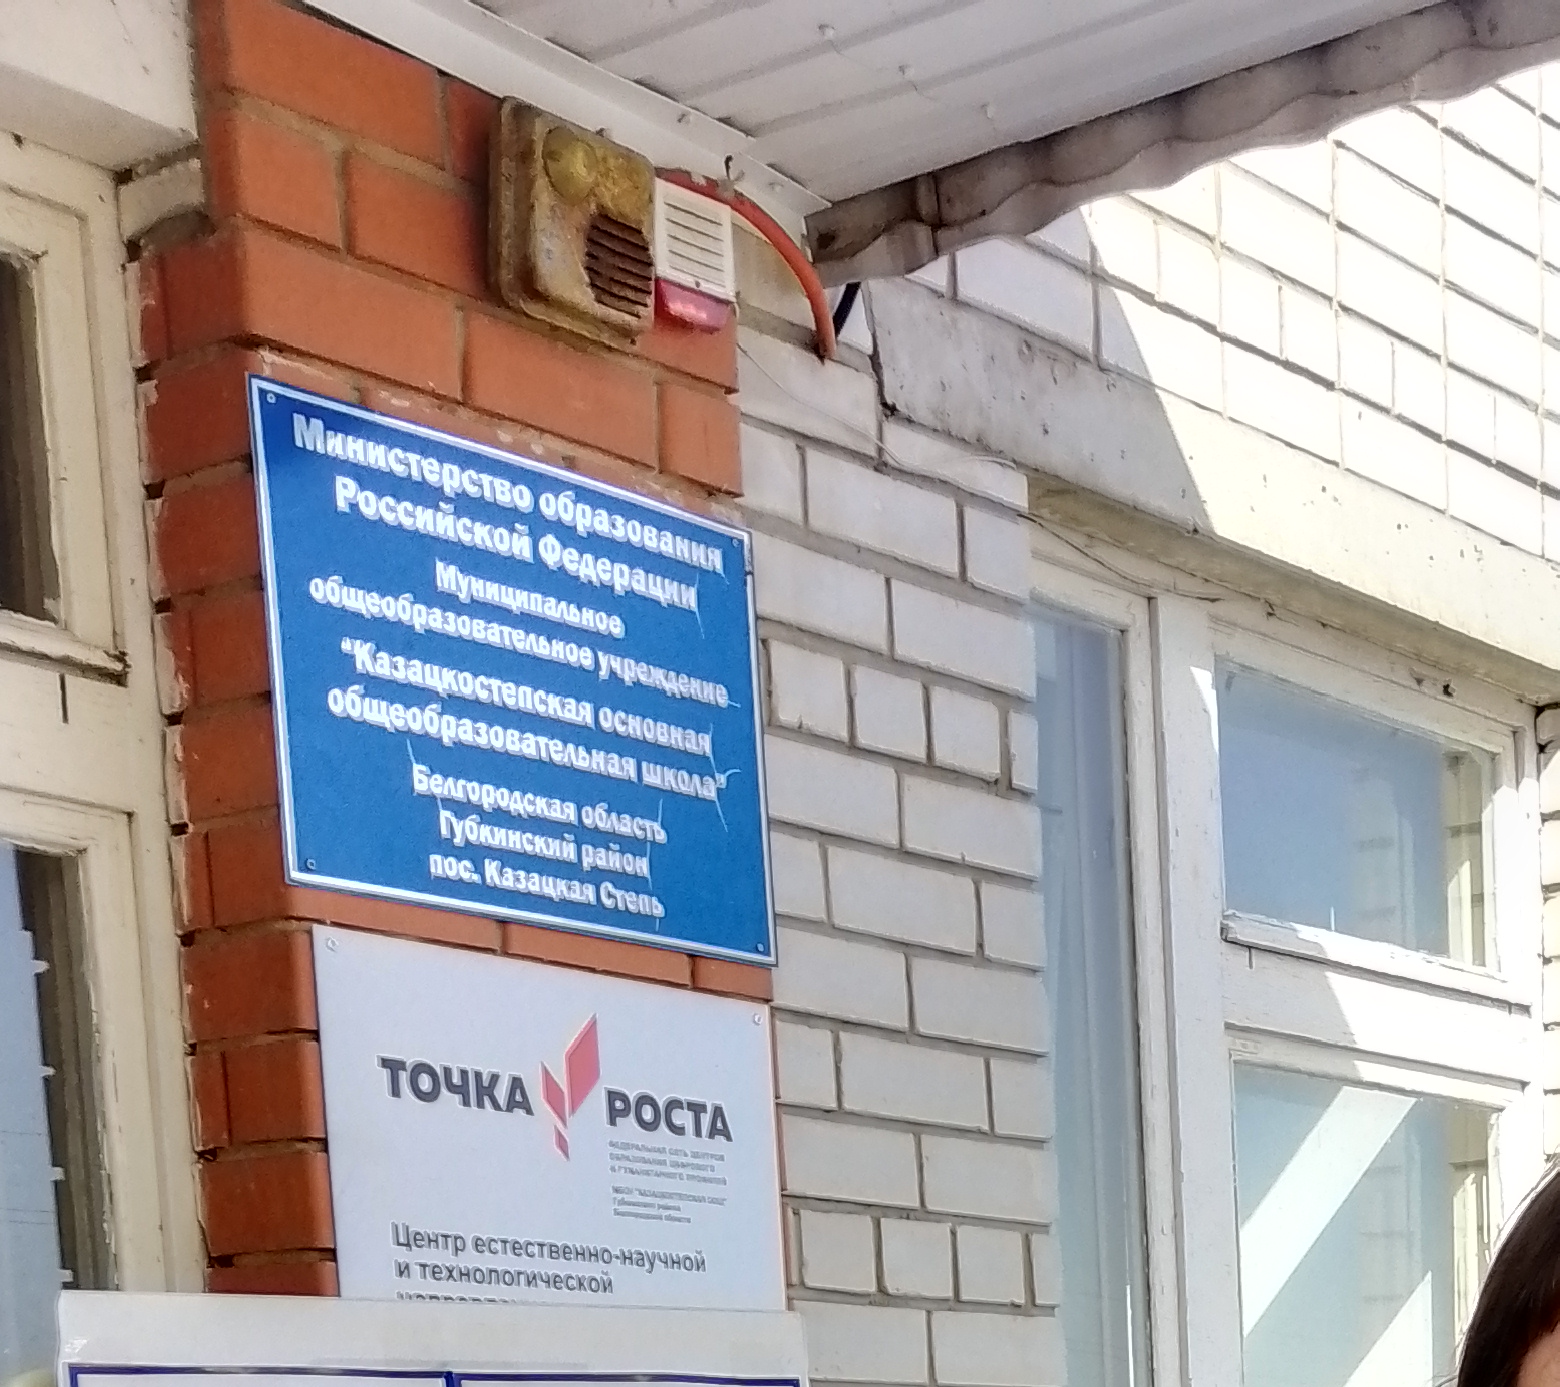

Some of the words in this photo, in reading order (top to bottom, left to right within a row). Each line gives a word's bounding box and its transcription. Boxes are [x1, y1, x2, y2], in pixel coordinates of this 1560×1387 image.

[293, 413, 533, 512] Министерство
[539, 490, 725, 573] образования
[334, 475, 533, 563] Российской
[538, 534, 698, 611] Федерации
[435, 558, 625, 637] Муниципальное
[310, 575, 594, 670] общеобразовательное
[598, 650, 729, 707] учреждение
[341, 636, 596, 729] "Казацкостепская
[600, 707, 712, 756] основная
[328, 685, 637, 780] общеобразовательная
[641, 760, 726, 800] школа"
[412, 763, 578, 825] Белгородская
[581, 803, 667, 844] область
[439, 810, 578, 863] Губкинский
[581, 843, 650, 878] район
[429, 854, 482, 884] пос.
[484, 858, 597, 905] Казацкая
[600, 880, 665, 918] Степь
[376, 1054, 535, 1117] ТОЧКА
[604, 1086, 733, 1142] РОСТА
[391, 1221, 466, 1257] Центр
[471, 1233, 706, 1274] естественно-научной
[394, 1258, 410, 1279] и
[415, 1260, 613, 1294] технологической
